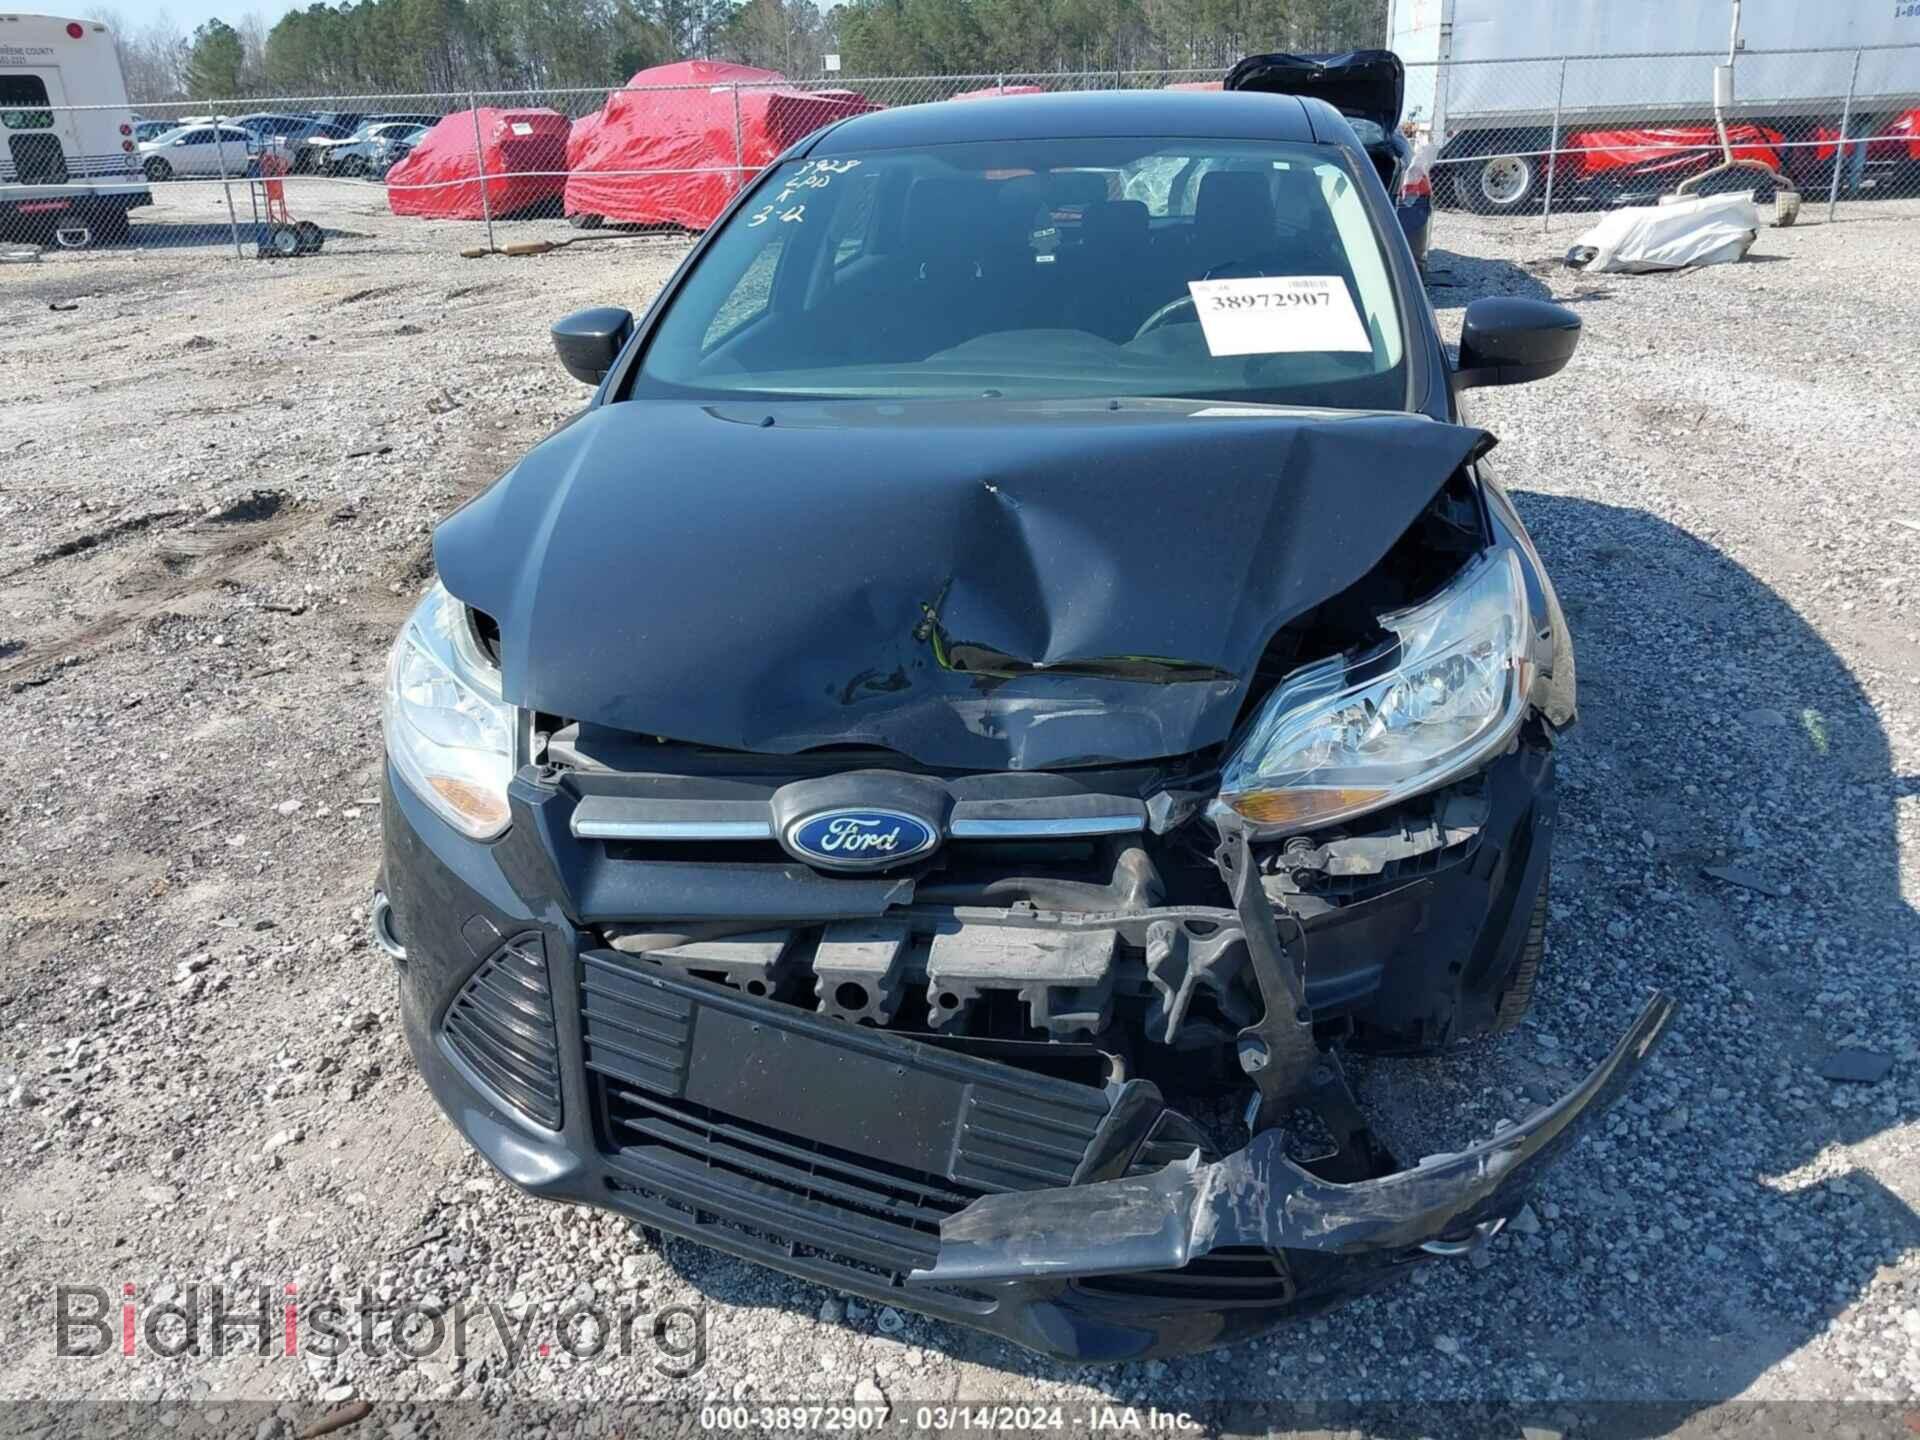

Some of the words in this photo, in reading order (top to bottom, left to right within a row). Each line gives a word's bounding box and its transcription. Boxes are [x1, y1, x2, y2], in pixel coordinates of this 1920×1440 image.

[25, 47, 55, 56] COUNTY
[1210, 292, 1330, 311] 38972907
[820, 817, 900, 851] Ford
